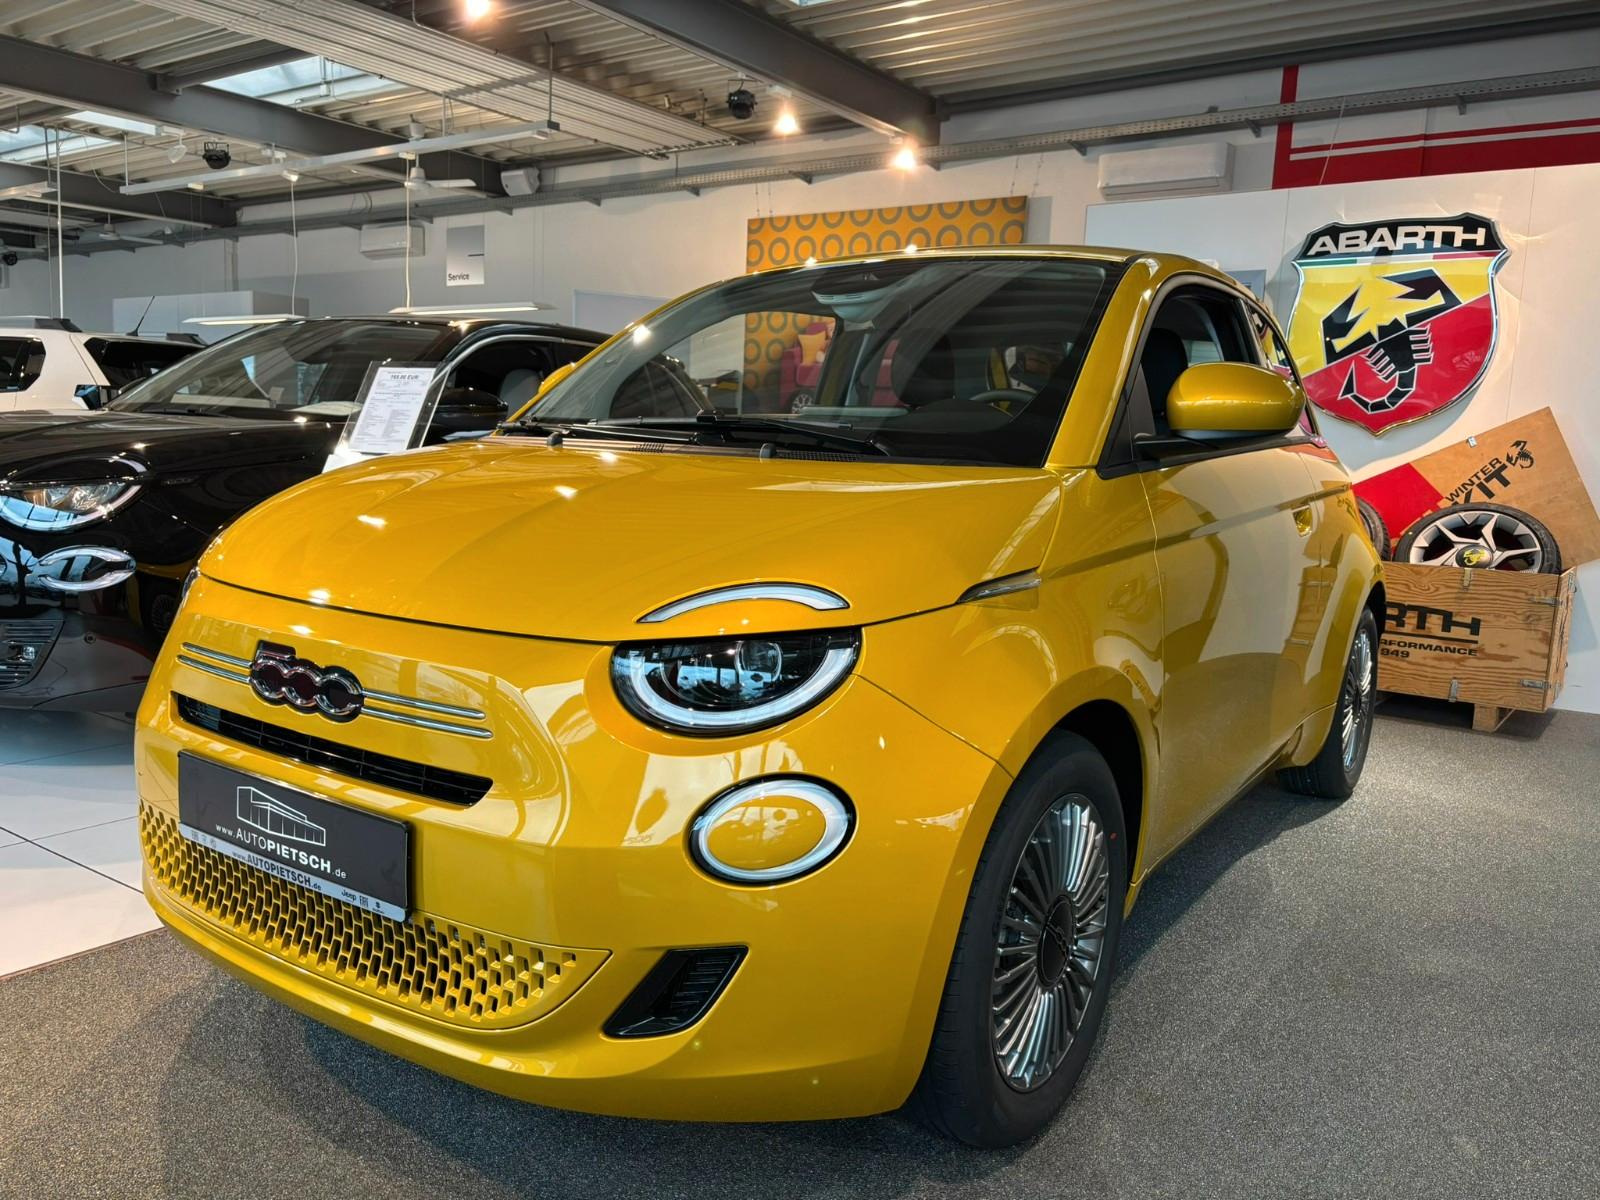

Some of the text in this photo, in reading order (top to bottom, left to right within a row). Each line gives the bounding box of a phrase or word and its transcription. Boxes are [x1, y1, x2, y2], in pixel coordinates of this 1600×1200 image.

[1306, 225, 1486, 256] ABARTH
[448, 273, 470, 281] Service
[1446, 457, 1502, 502] WINTER
[215, 824, 347, 879] www.AUTOPIETSCH.de
